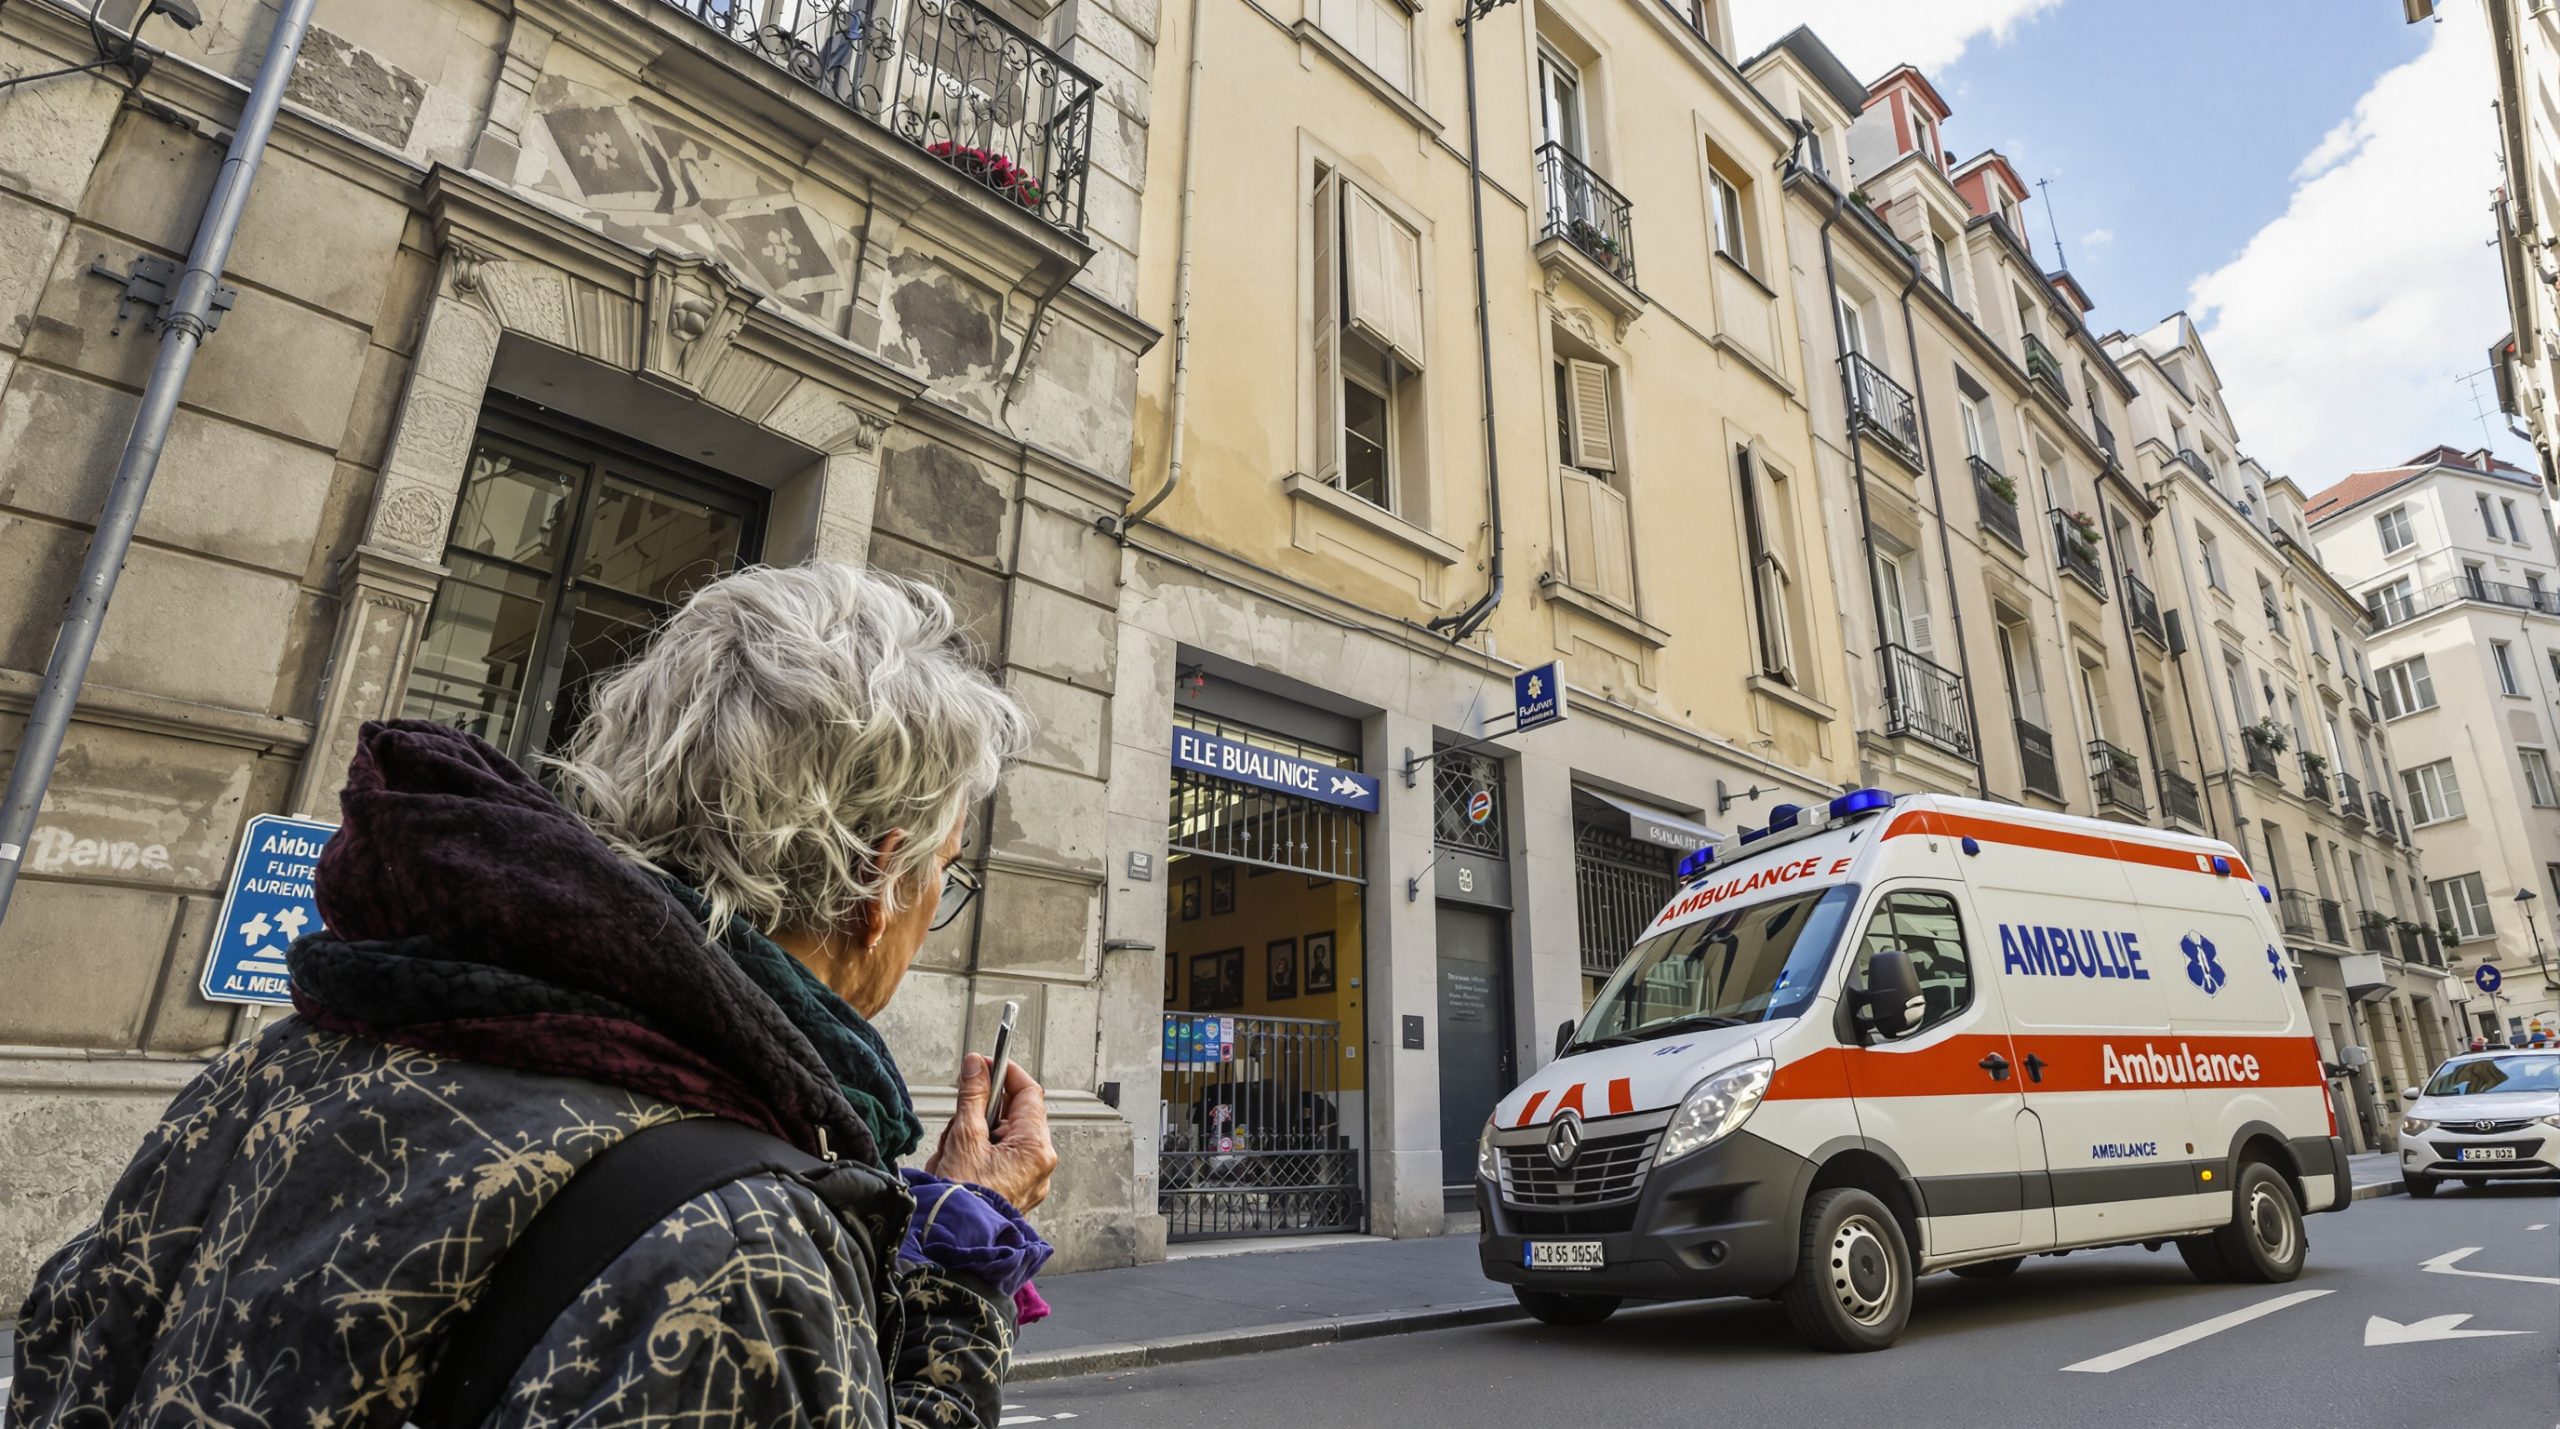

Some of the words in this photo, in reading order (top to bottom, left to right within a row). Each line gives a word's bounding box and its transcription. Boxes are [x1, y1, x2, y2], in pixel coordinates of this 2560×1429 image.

[1180, 735, 1218, 768] ELE
[1222, 745, 1320, 792] BUALINICE
[1656, 856, 1823, 928] AMBULANCE
[1828, 857, 1852, 875] E
[224, 975, 244, 990] AL
[2103, 1042, 2260, 1084] Ambulance
